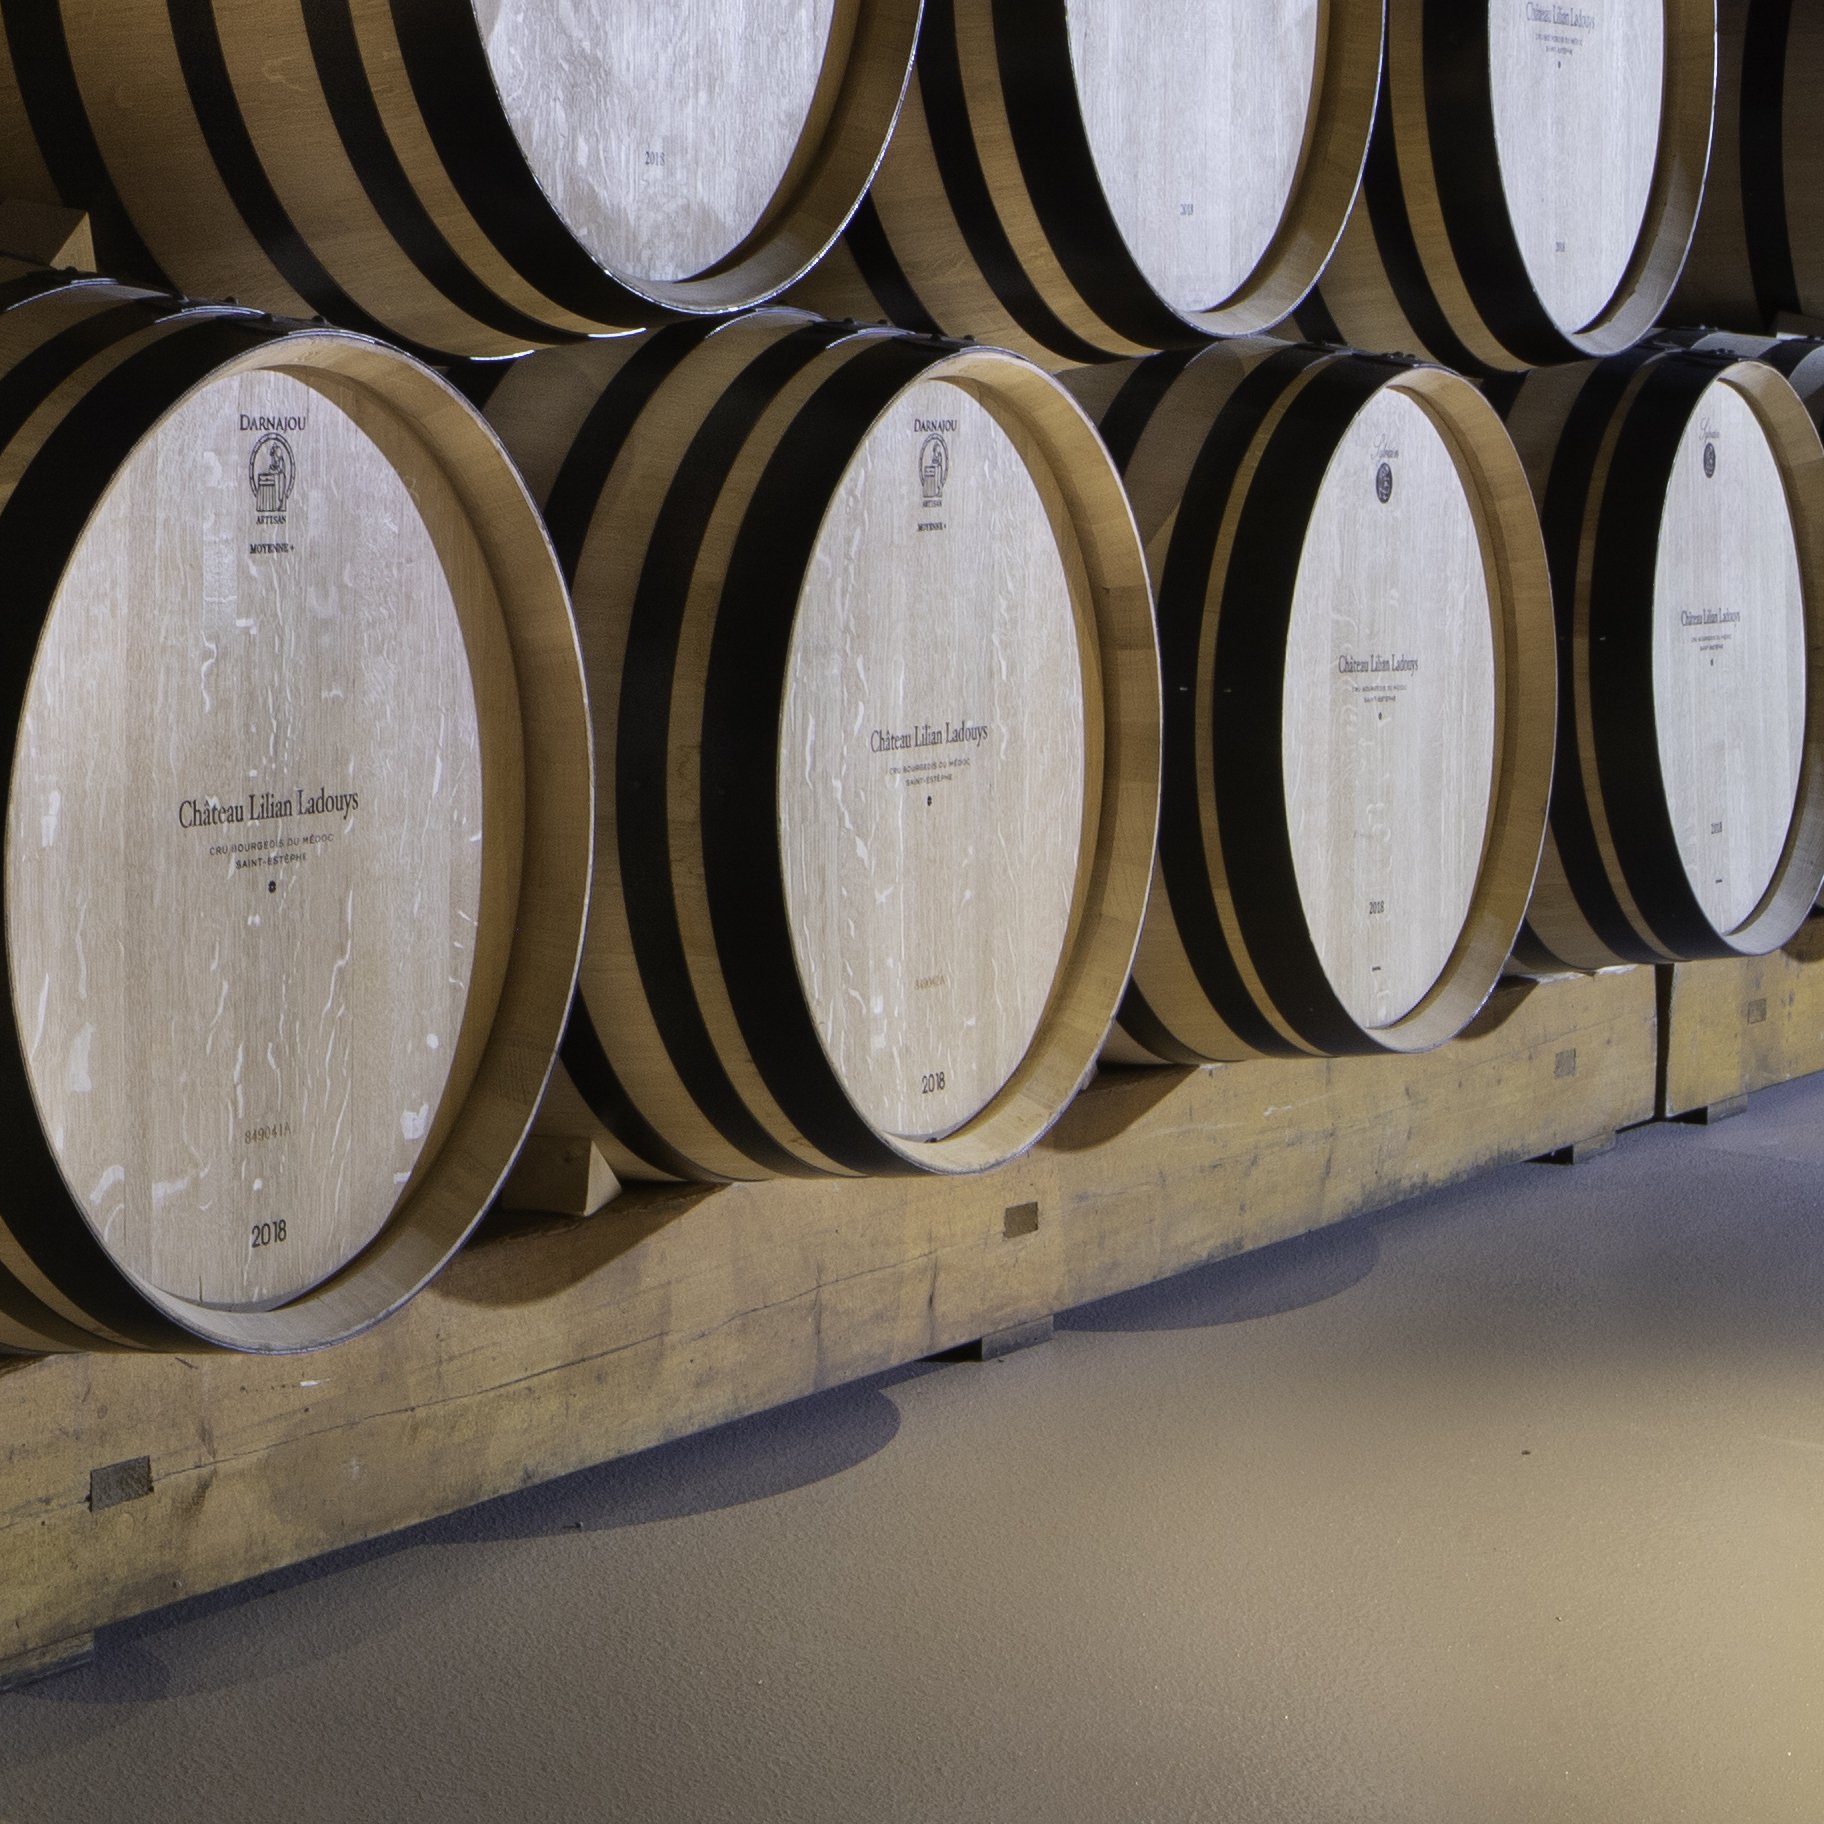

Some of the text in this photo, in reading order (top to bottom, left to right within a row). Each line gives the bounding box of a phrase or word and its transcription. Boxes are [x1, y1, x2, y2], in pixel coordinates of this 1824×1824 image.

[645, 152, 666, 166] 2018
[240, 414, 306, 433] DARNAJOU
[914, 419, 958, 433] DARNAJOU
[256, 515, 286, 526] ARTISAN
[250, 544, 289, 554] MOYENNE
[1339, 653, 1419, 677] Château Lilian Ladouys
[871, 721, 988, 753] Château Lilian Ladouys
[890, 767, 901, 775] CRU
[903, 763, 937, 775] BOURGEOIS
[179, 787, 359, 829] Château Lilian Ladouys
[210, 834, 334, 856] CRU BOURGEOIS DU MÉDOC
[1369, 900, 1385, 915] 2018
[922, 1071, 946, 1094] 2018
[252, 1219, 287, 1248] 2018
